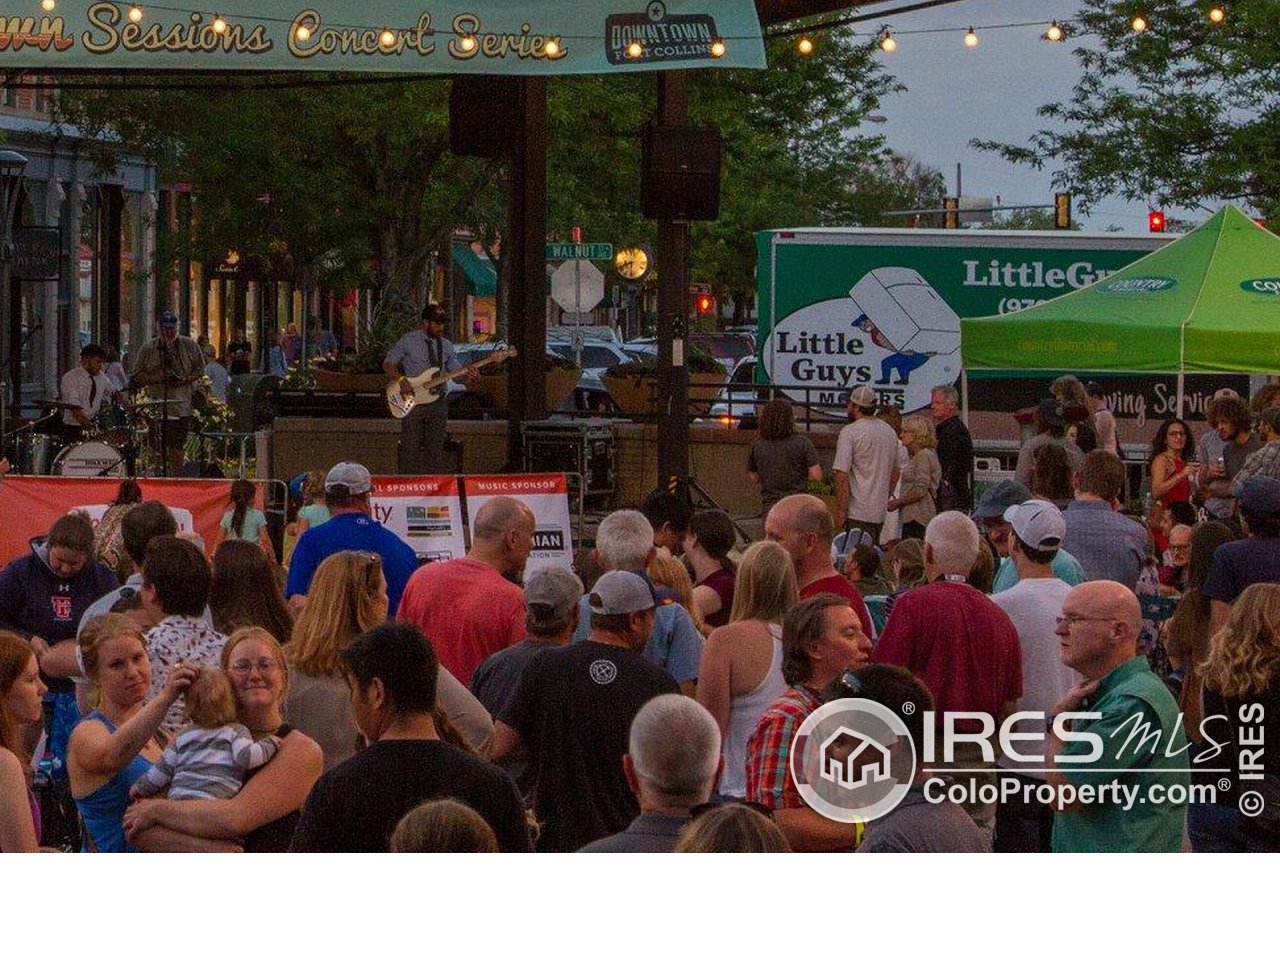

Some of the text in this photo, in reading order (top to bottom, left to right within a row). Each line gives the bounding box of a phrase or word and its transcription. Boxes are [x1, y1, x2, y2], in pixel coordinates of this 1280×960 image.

[82, 1, 273, 55] Sessions
[287, 8, 436, 59] Concrt
[611, 23, 712, 50] DOWNTOWN
[614, 48, 652, 60] FOT
[552, 245, 595, 258] WALNUT
[776, 331, 865, 355] Little
[791, 358, 872, 387] Guys
[819, 391, 905, 410] MORS
[1106, 383, 1213, 428] ving Servic
[386, 483, 439, 493] SPONSORS
[478, 480, 556, 490] MUSIC SPONSOR
